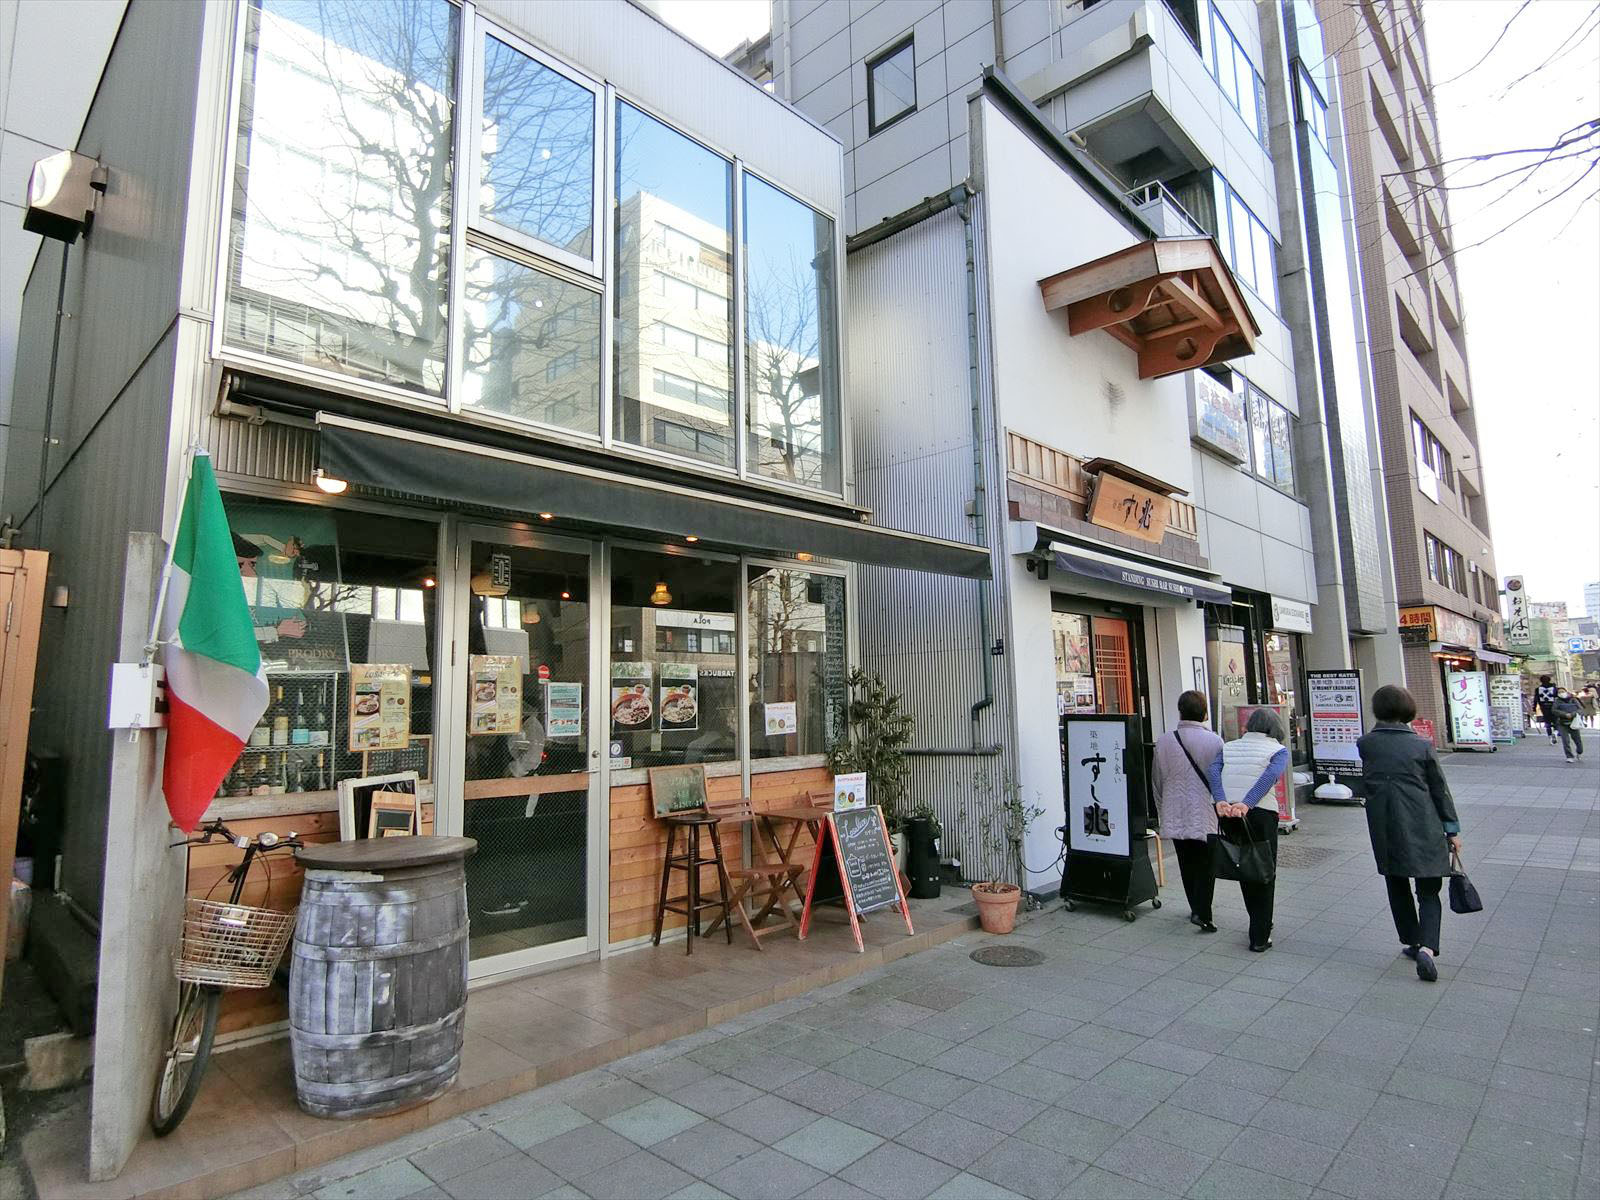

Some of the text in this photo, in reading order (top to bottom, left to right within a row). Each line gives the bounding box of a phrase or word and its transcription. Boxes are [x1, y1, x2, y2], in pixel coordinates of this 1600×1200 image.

[1121, 571, 1145, 585] STANDING
[1159, 580, 1168, 590] BAR
[1511, 596, 1528, 631] おそば
